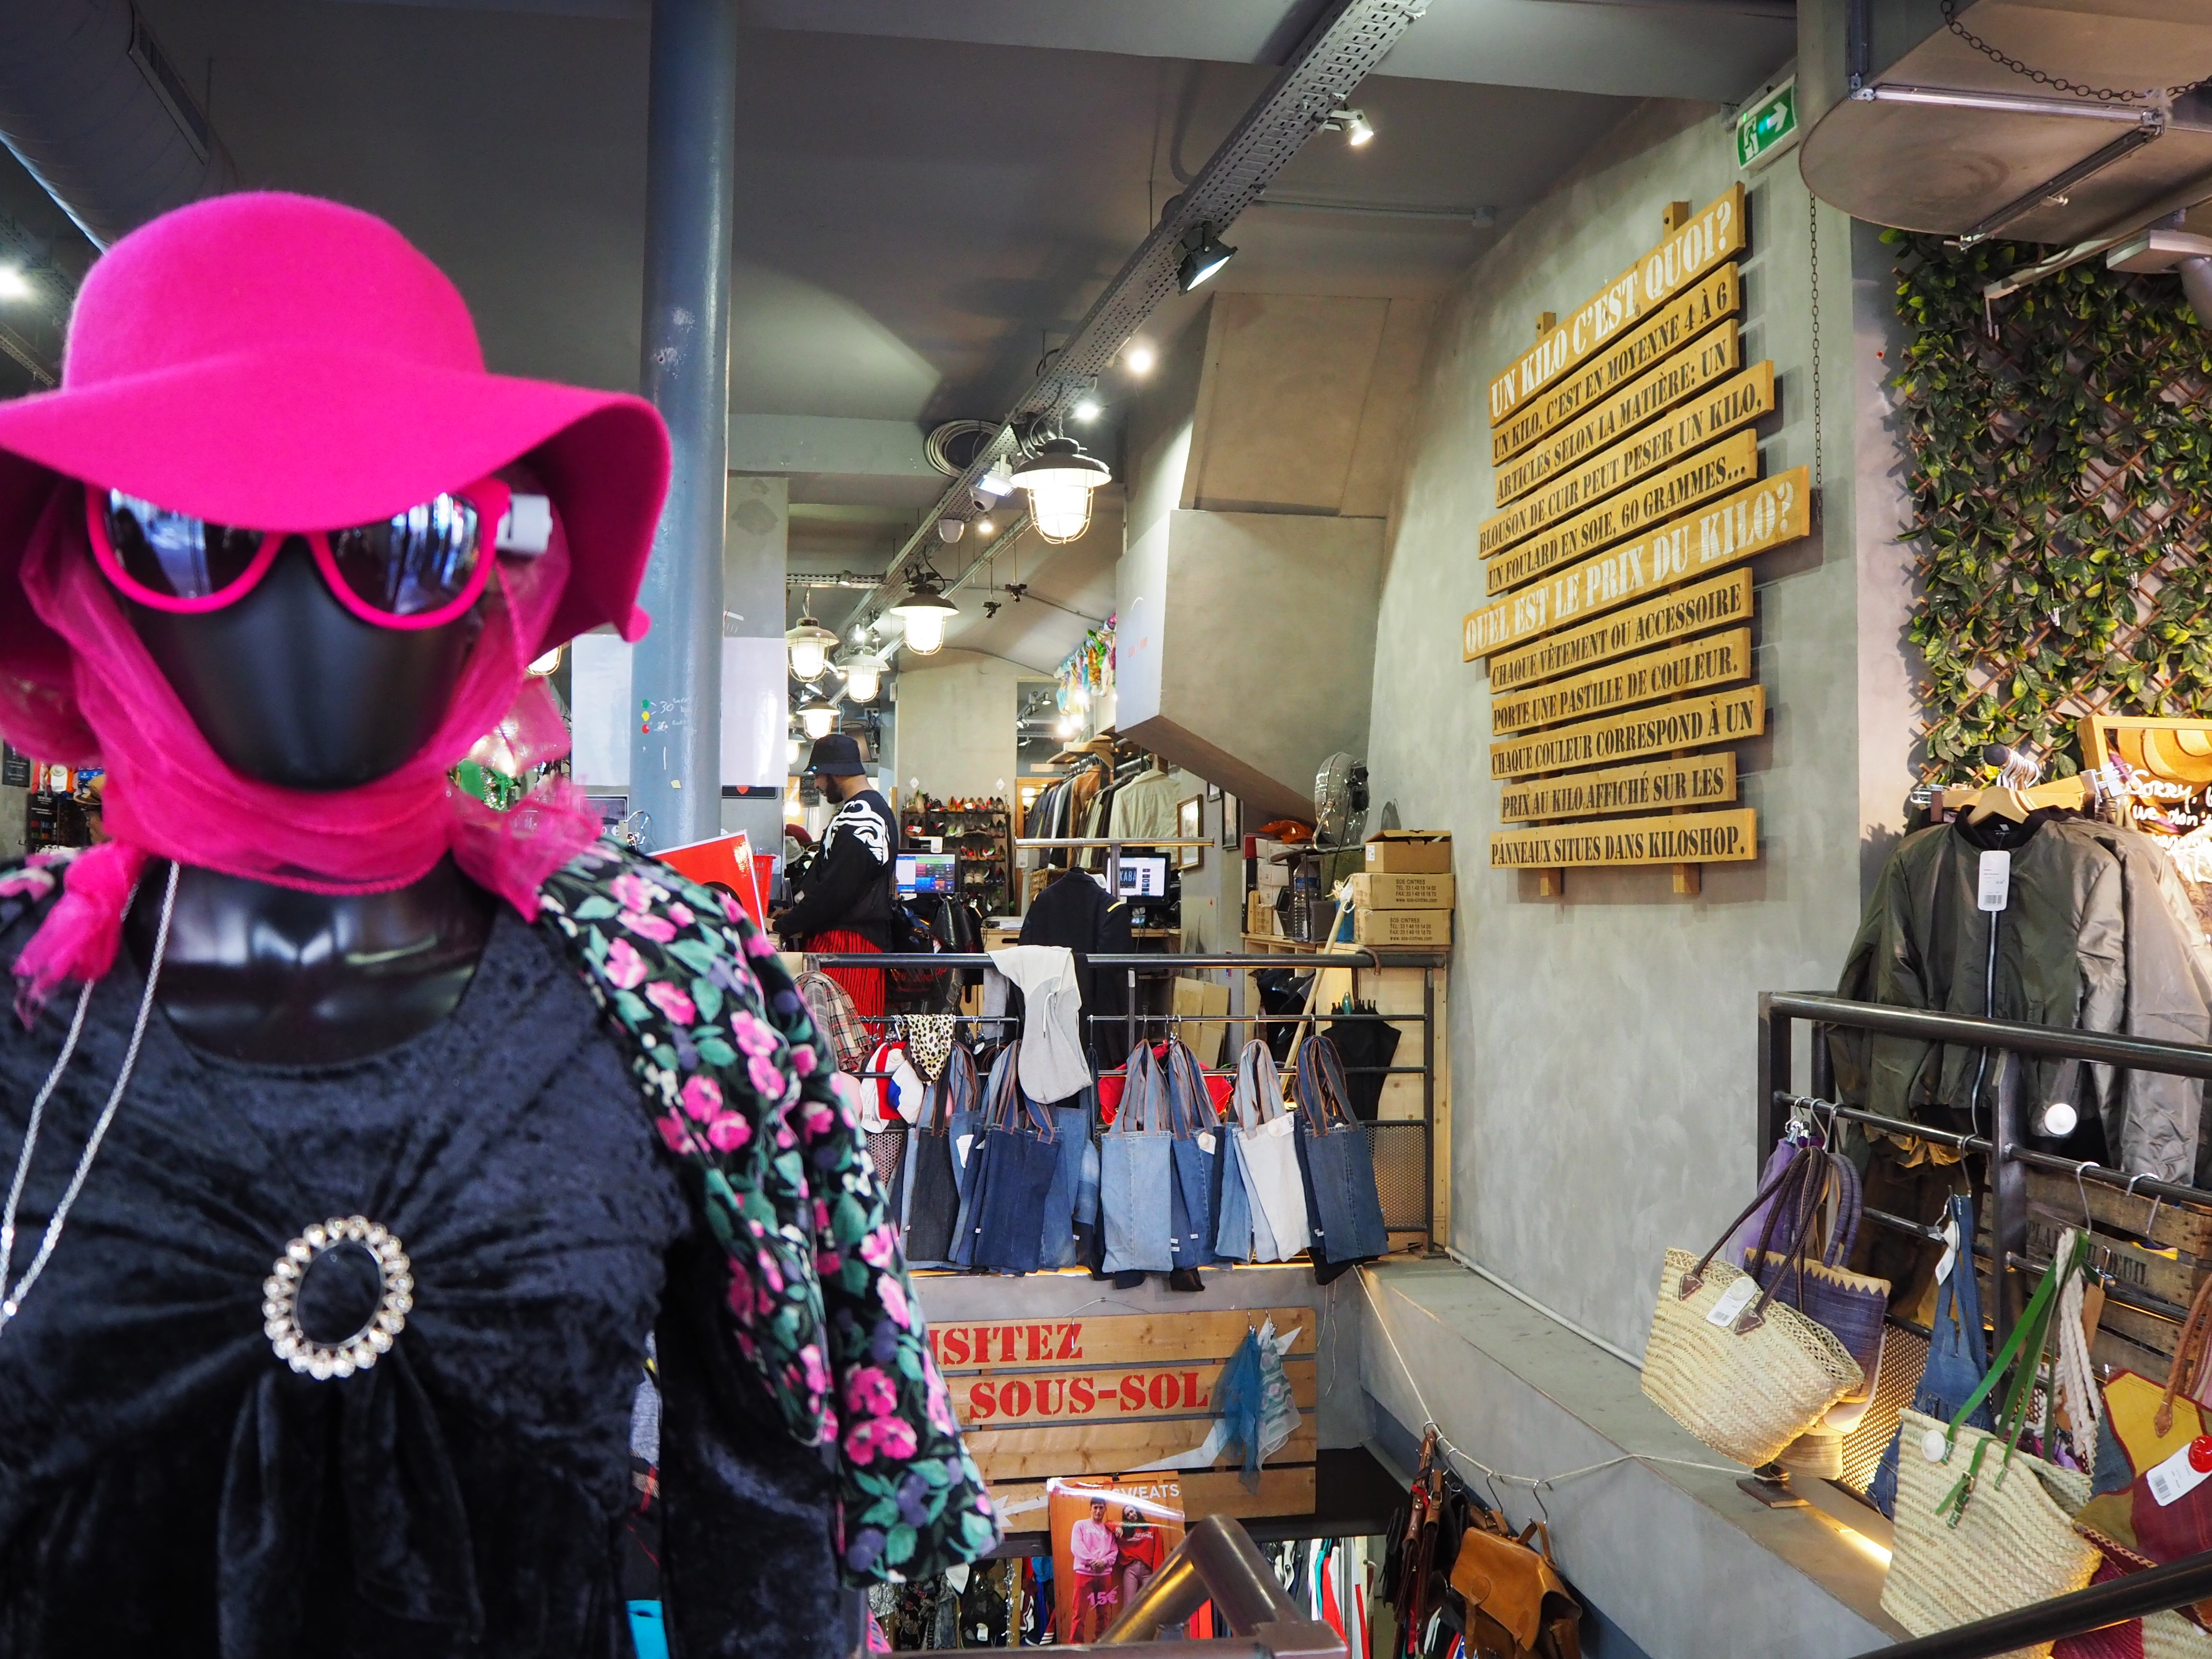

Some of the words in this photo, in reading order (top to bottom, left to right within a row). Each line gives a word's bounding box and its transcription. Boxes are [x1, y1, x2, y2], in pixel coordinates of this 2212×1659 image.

[1491, 369, 1516, 417] UN
[1521, 329, 1567, 397] KILO
[1573, 271, 1637, 354] C'EST
[1646, 201, 1731, 300] QUOI?
[1494, 432, 1509, 459] UN
[1513, 412, 1542, 448] KILO,
[1547, 382, 1581, 424] C'EST
[1586, 367, 1603, 399] EN
[1607, 314, 1679, 385] MOYENNE
[1684, 304, 1694, 332] 4
[1700, 288, 1711, 324] À
[1717, 282, 1727, 310] 6
[1497, 450, 1551, 502] ARTICLES
[1554, 421, 1594, 467] SELON
[1599, 410, 1615, 441] LA
[1620, 361, 1695, 428] MATIÈRE:
[1701, 338, 1726, 377] UN
[1480, 508, 1527, 554] BLOUSON
[1530, 499, 1545, 527] DE
[1548, 480, 1579, 517] CUIR
[1583, 457, 1619, 499] PEUT
[1624, 426, 1674, 478] PESER
[1679, 410, 1703, 446] UN
[1710, 383, 1762, 432] KILO,
[1466, 606, 1509, 654] QUEL
[1514, 586, 1549, 635] EST
[1554, 571, 1580, 620] LE
[1586, 544, 1645, 608] PRIX
[1652, 524, 1691, 582] DU
[1699, 481, 1794, 564] KILO?
[1489, 565, 1503, 590] UN
[1506, 539, 1558, 583] FOULARD
[1561, 529, 1578, 557] EN
[1581, 511, 1617, 548] SOIE,
[1622, 499, 1639, 528] 60
[1643, 456, 1745, 518] GRAMMES...
[1492, 654, 1538, 688] CHAQUE
[1539, 627, 1608, 670] VÊTEMENT
[1611, 621, 1633, 650] OU
[1635, 583, 1741, 643] ACCESSOIRE
[660, 701, 673, 713] 30
[1493, 700, 1530, 731] PORTE
[1532, 691, 1557, 722] UNE
[1560, 676, 1623, 718] PASTILLE
[1628, 669, 1647, 698] DE
[1651, 646, 1738, 692] COULEUR.
[1492, 747, 1532, 775] CHAQUE
[1535, 734, 1593, 768] COULEUR
[1596, 711, 1703, 757] CORRESPOND
[1707, 701, 1720, 736] À
[1726, 700, 1754, 733] UN
[1503, 793, 1530, 817] PRIX
[1532, 790, 1549, 815] AU
[1552, 785, 1583, 811] KILO
[1587, 771, 1649, 808] AFFICHÉ
[1653, 773, 1687, 802] SUR
[1692, 767, 1723, 797] LES
[1491, 839, 1551, 865] PANNEAUX
[1554, 835, 1600, 863] SITUES
[1605, 833, 1644, 860] DANS
[1648, 825, 1745, 858] KILOSHOP.
[970, 1372, 1208, 1419] SOUS-SOL
[1087, 1590, 1118, 1607] 15€
